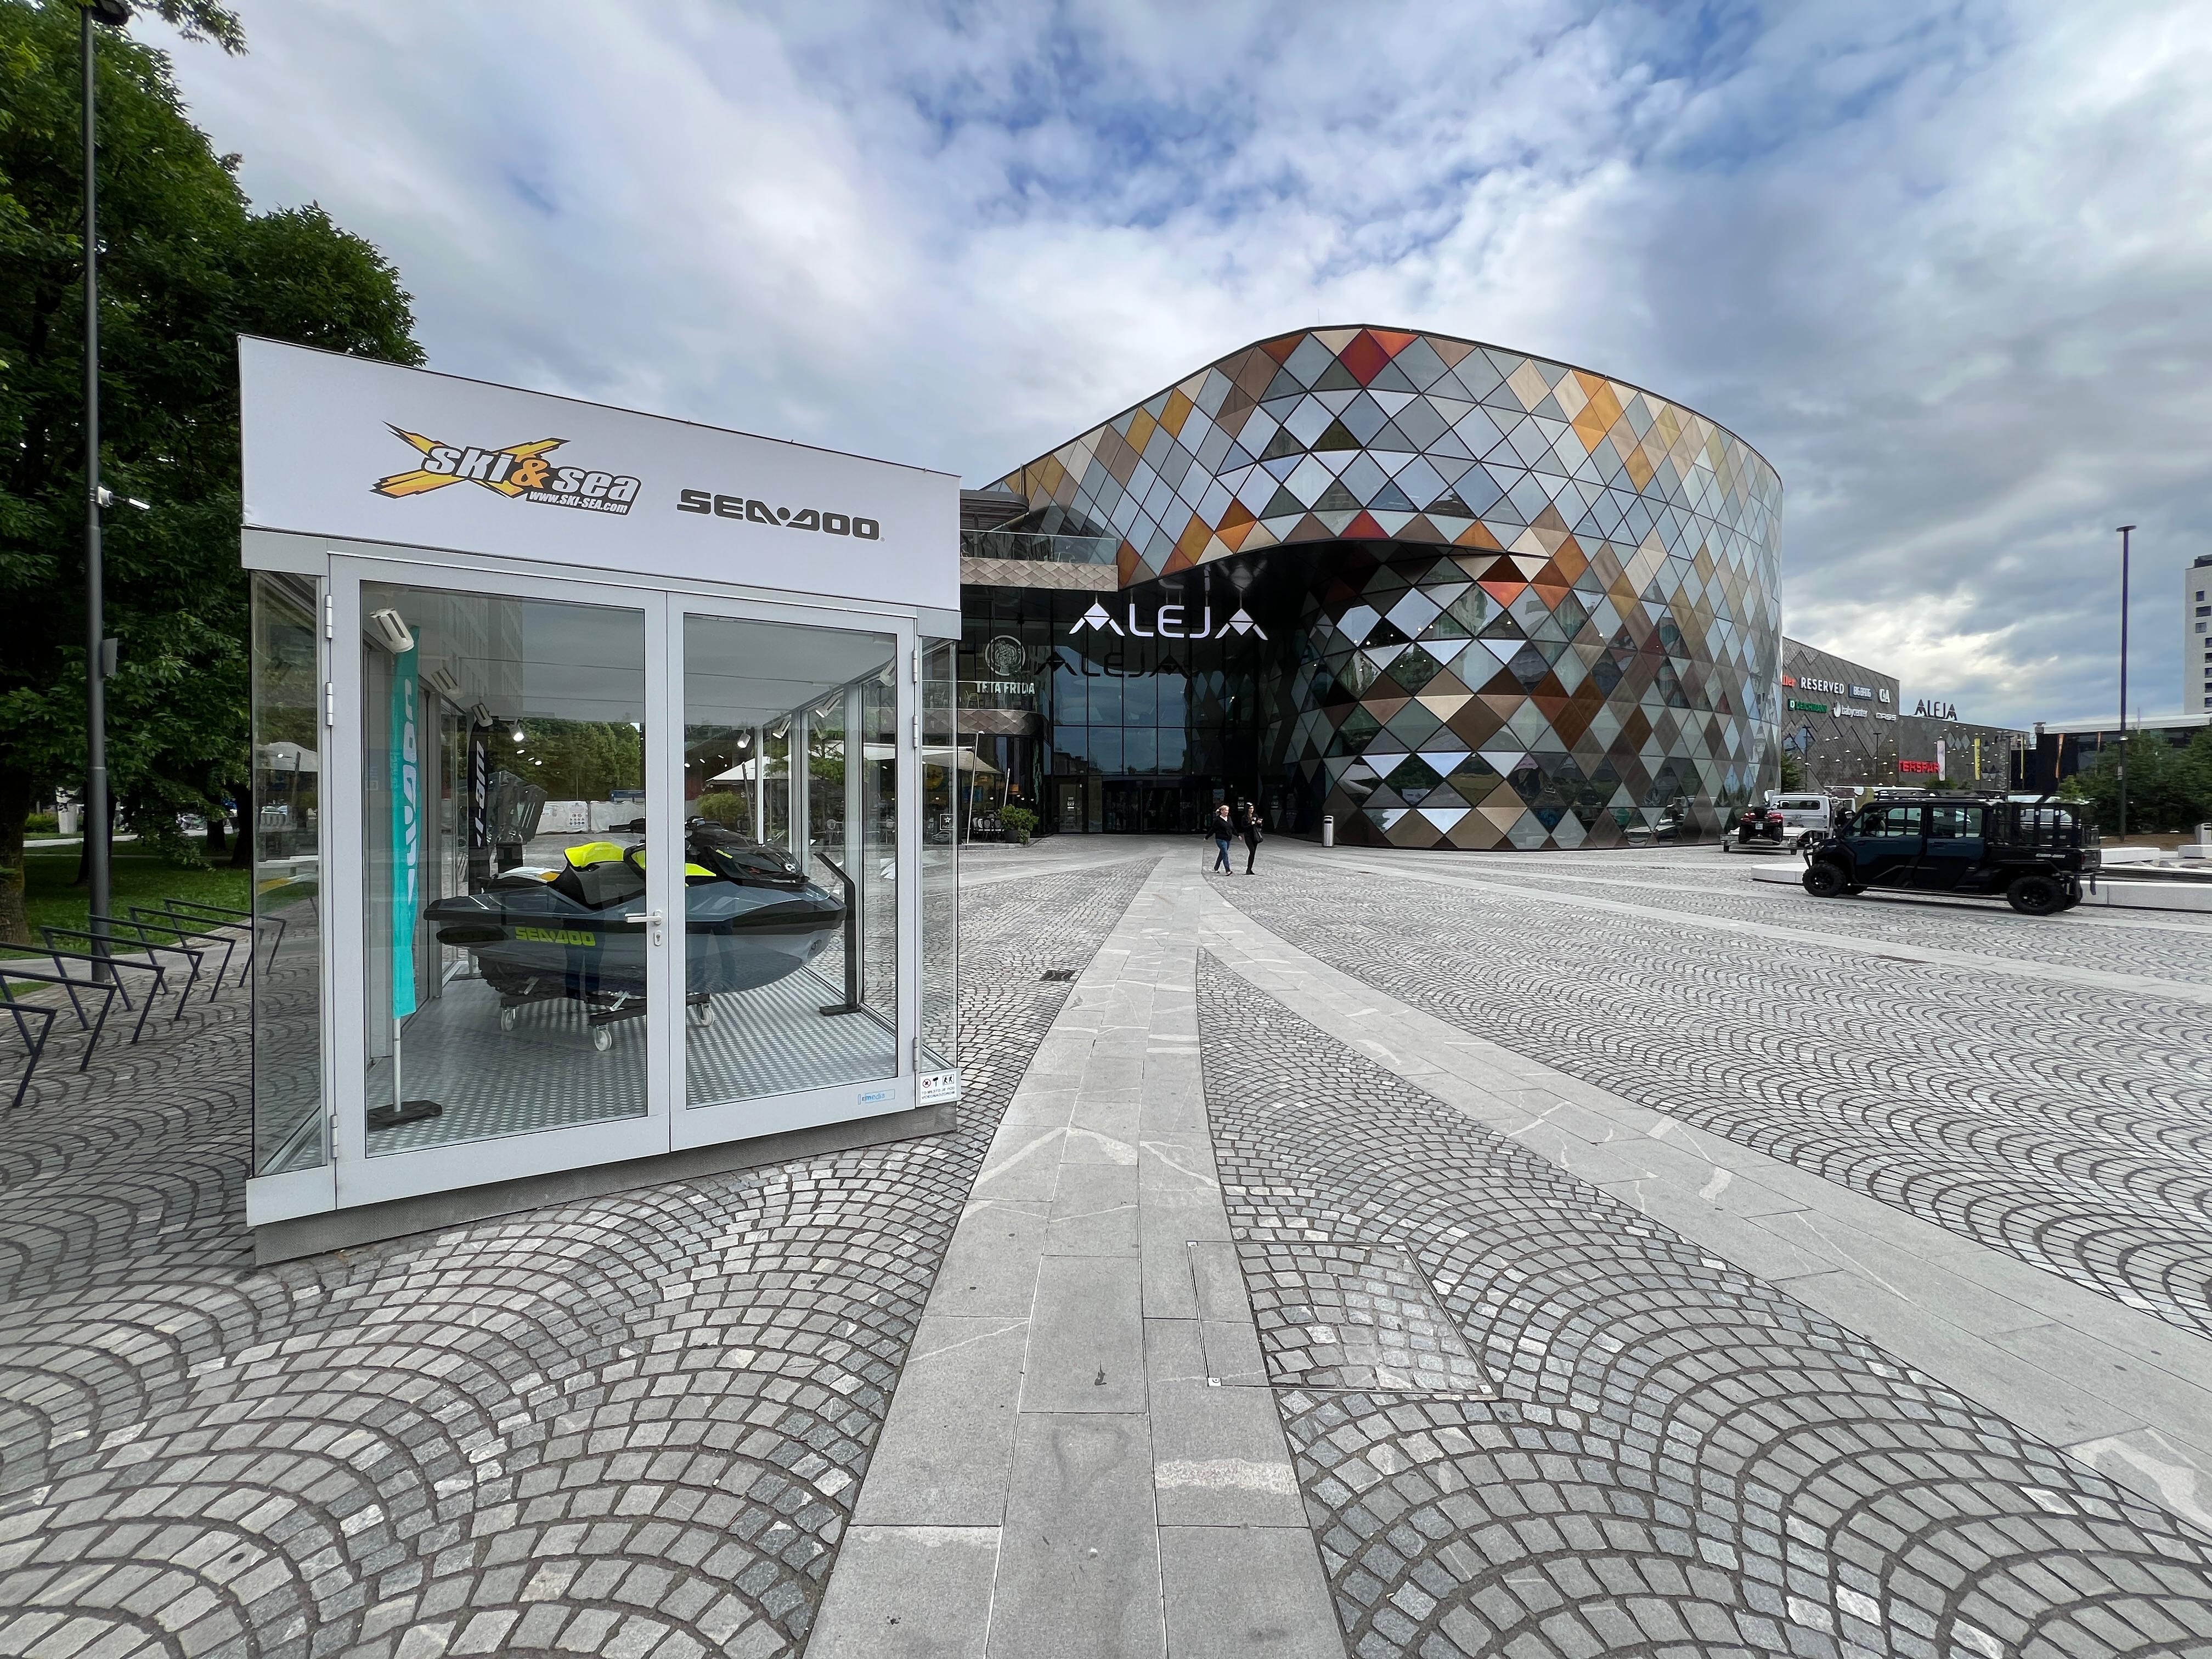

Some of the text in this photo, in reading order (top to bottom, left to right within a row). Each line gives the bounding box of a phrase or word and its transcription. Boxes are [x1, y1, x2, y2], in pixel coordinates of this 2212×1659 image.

[1068, 602, 1268, 641] ALEJA
[1800, 676, 1844, 695] RESERVED
[1915, 699, 1957, 721] ALEJA
